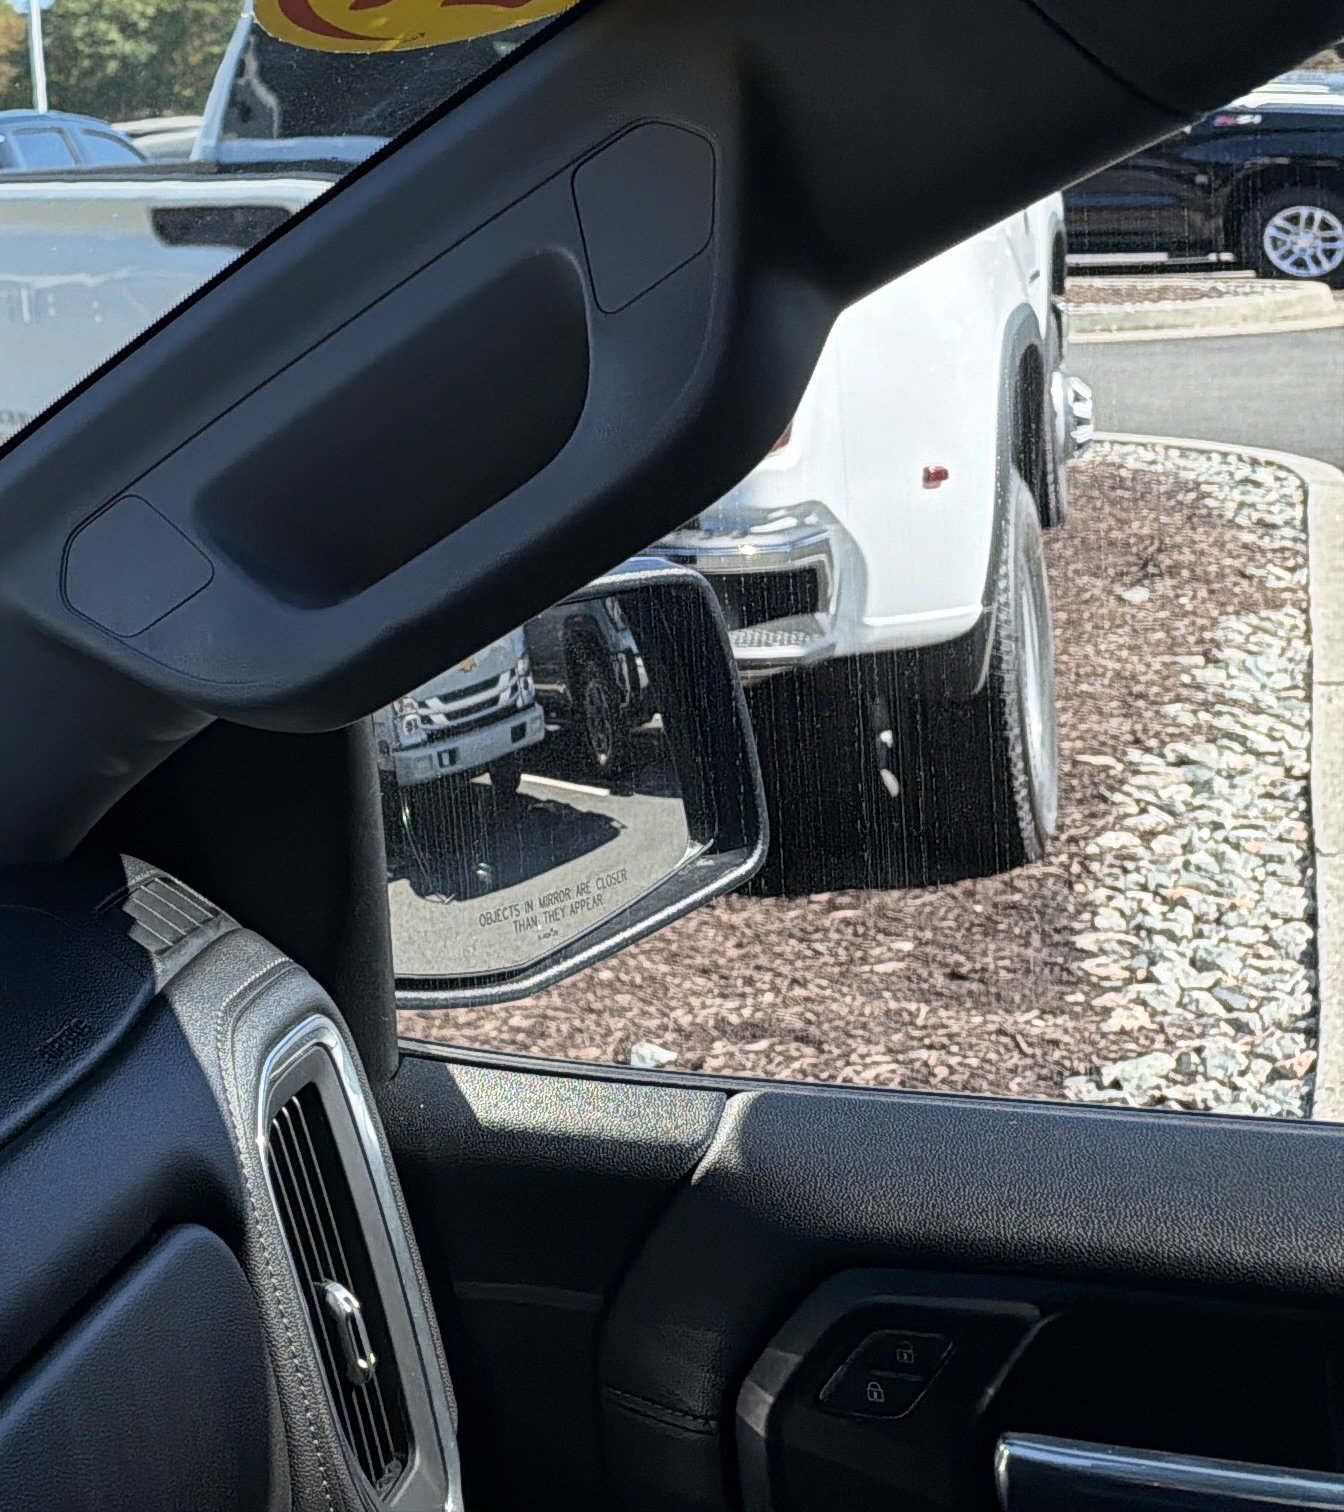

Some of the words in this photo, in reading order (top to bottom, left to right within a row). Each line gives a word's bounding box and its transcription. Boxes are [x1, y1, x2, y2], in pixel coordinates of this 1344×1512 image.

[478, 903, 520, 928] OBJECTS
[524, 898, 534, 914] IN
[538, 888, 572, 909] MIRROR
[575, 880, 592, 897] ARE
[596, 867, 628, 891] CLOSER
[512, 915, 538, 934] THAN
[542, 906, 566, 925] THEY
[569, 894, 604, 915] APPEAR
